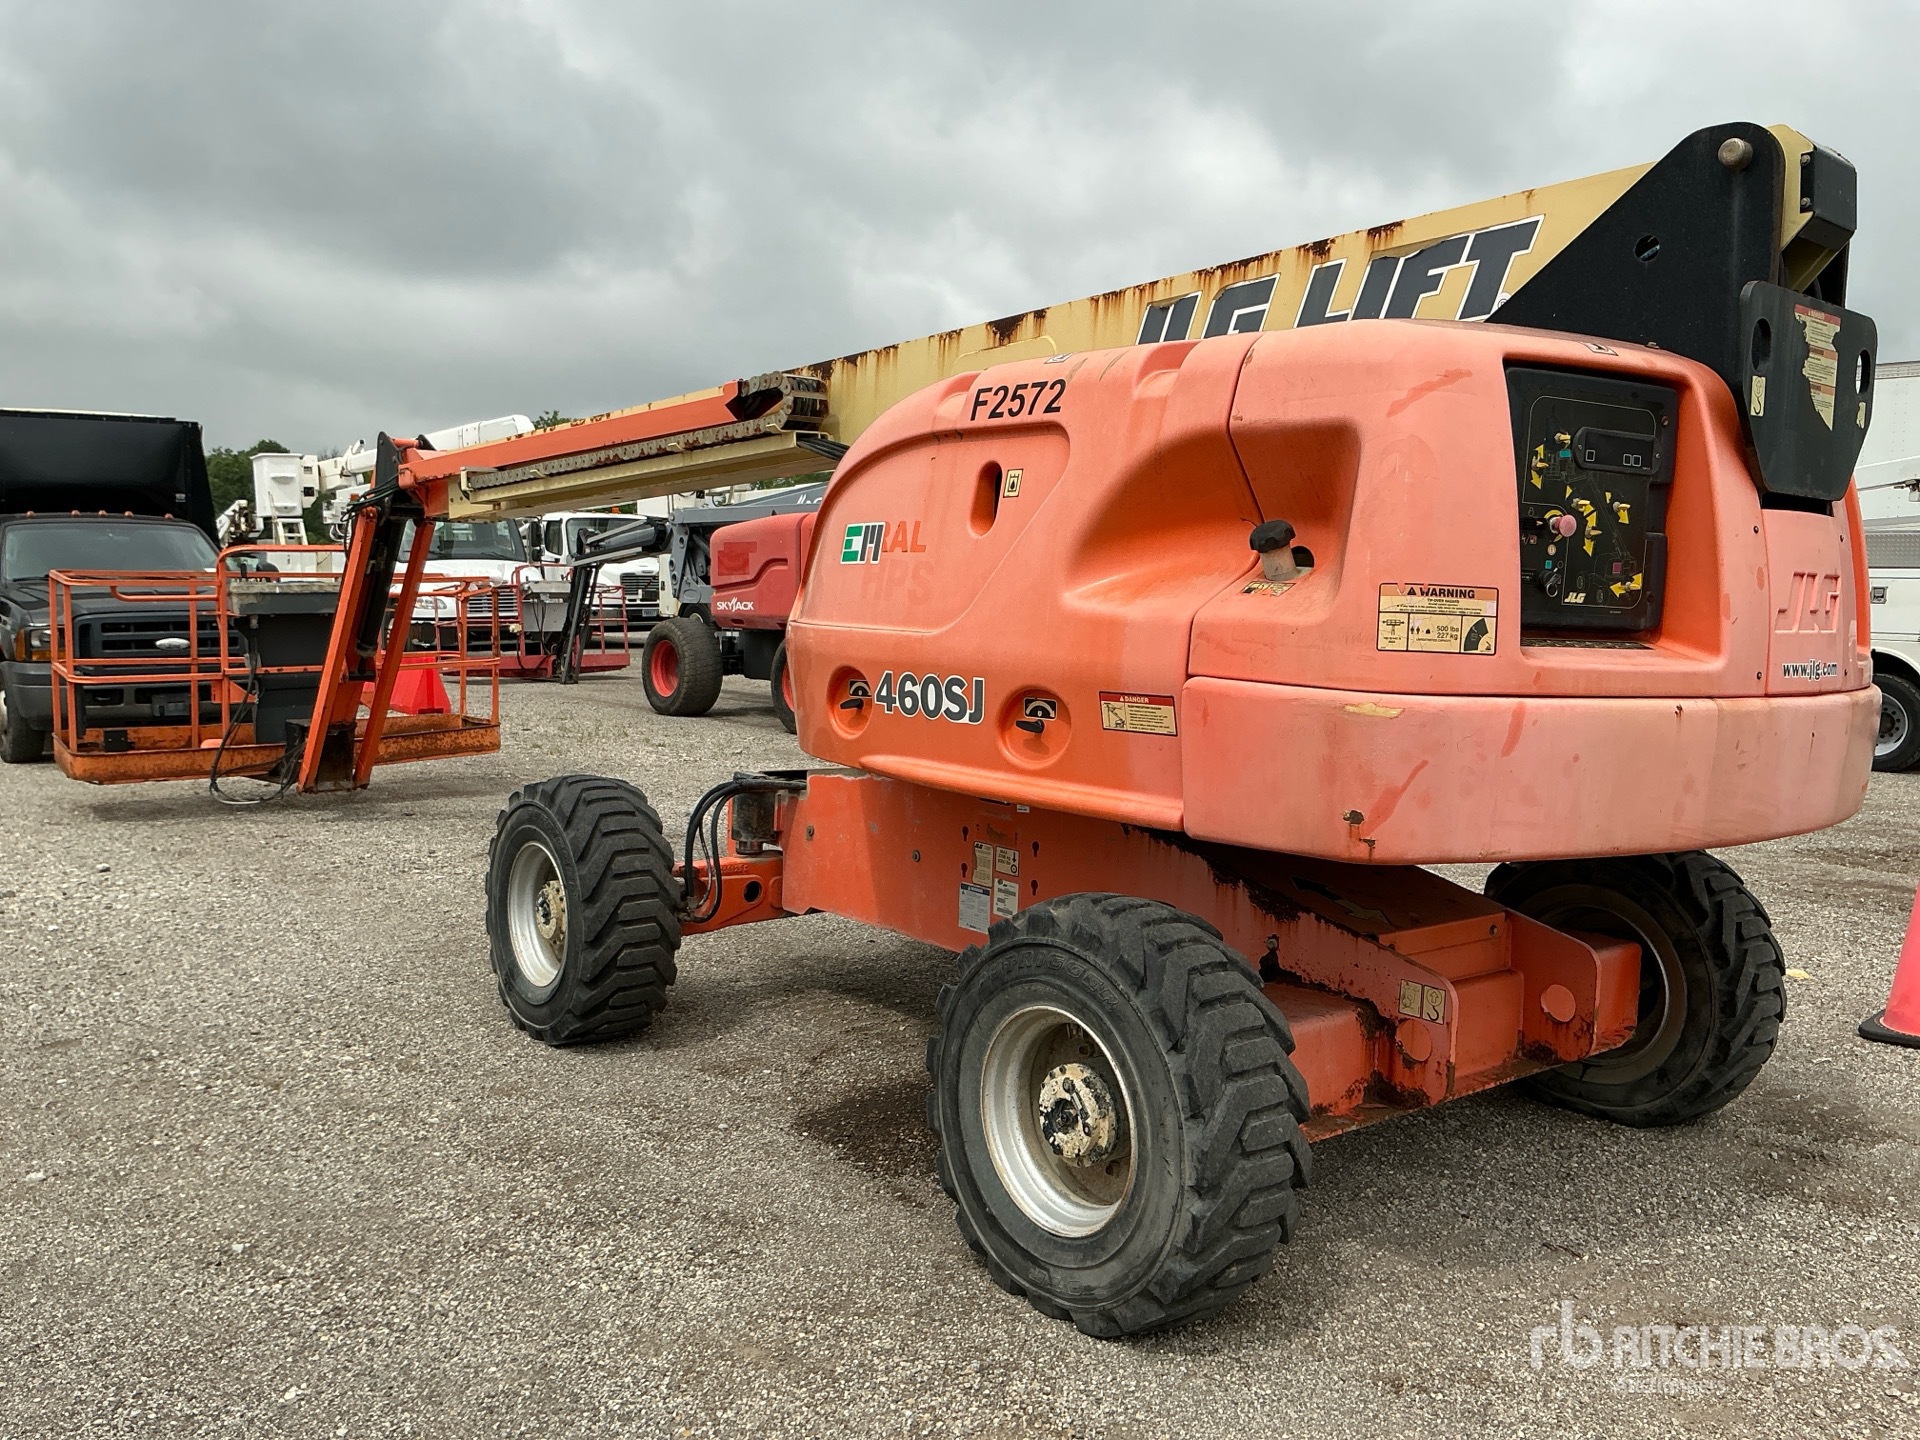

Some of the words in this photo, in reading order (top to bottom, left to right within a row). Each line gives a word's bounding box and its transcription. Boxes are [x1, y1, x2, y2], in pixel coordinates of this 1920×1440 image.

[1295, 214, 1545, 328] LIFT
[970, 378, 1066, 421] F2572
[1419, 587, 1476, 600] WARNING
[1564, 591, 1587, 604] JLG
[1774, 571, 1840, 634] JLG
[716, 596, 755, 612] SKYJACK
[1450, 633, 1459, 641] kg
[1782, 659, 1838, 680] www.jlg.com
[874, 670, 984, 725] 460SJ
[1124, 695, 1150, 704] DANGER
